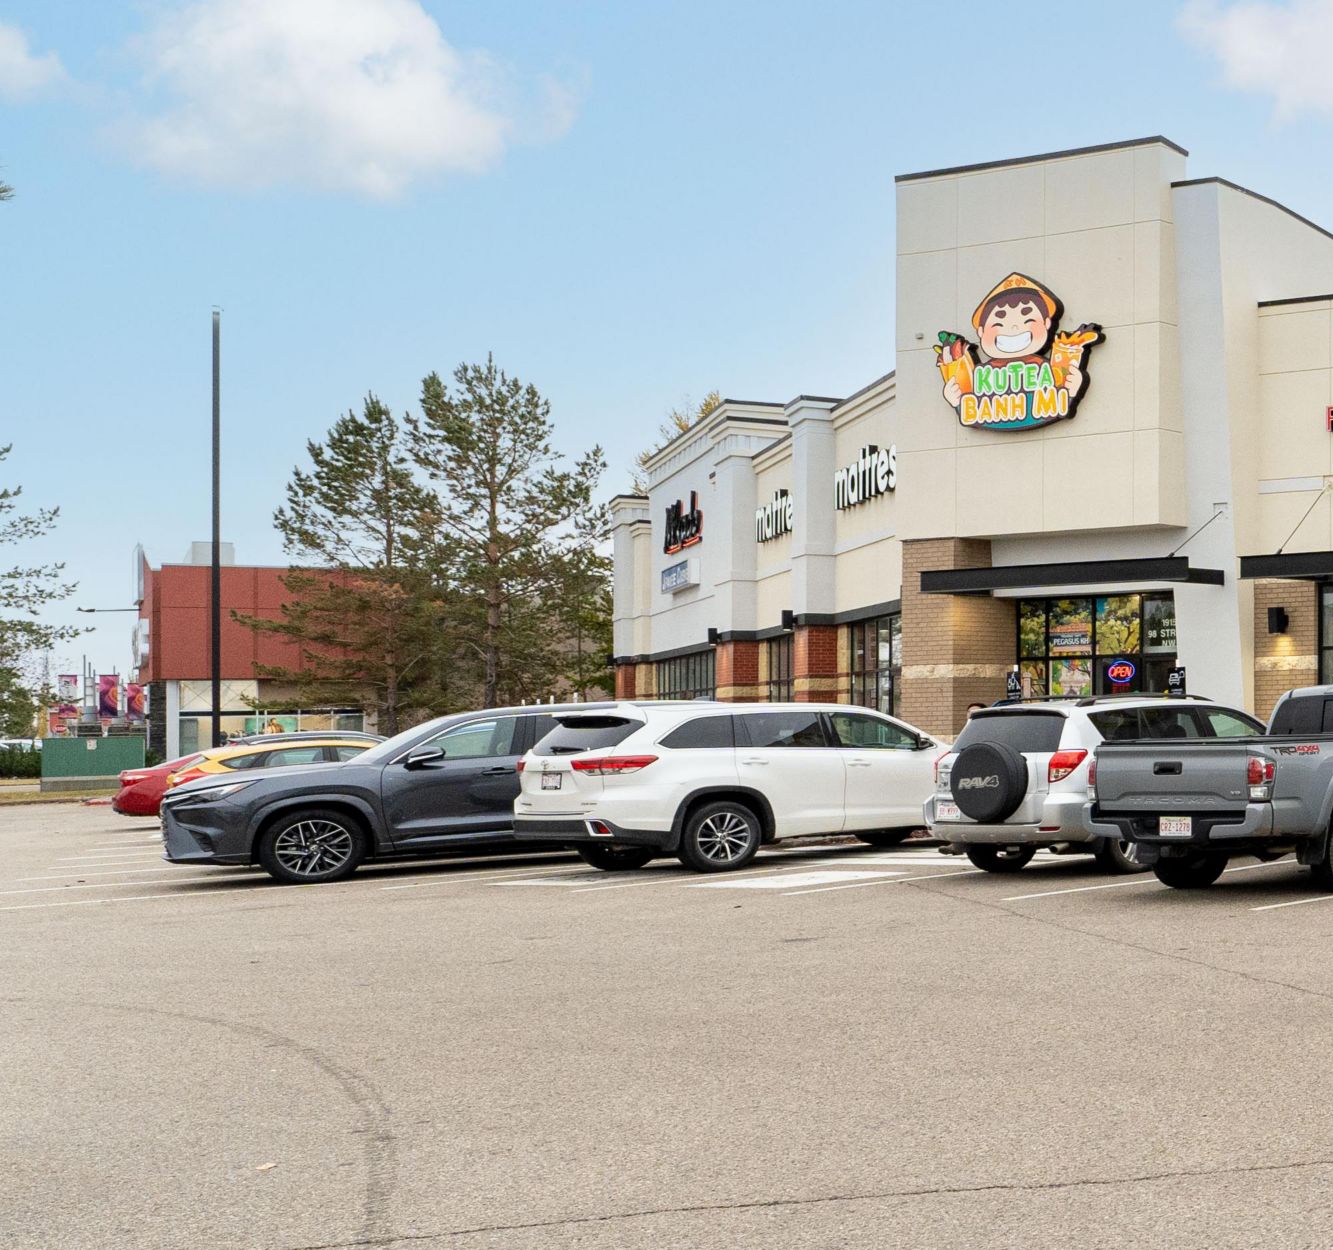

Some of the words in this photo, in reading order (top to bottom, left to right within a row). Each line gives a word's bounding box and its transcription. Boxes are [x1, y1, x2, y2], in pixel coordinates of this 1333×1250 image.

[975, 362, 1054, 395] KUTEA
[961, 394, 1026, 424] BANH
[1033, 387, 1068, 417] MI
[1148, 630, 1157, 638] 98
[1053, 637, 1080, 646] PEGASUS
[1110, 664, 1132, 677] OPEN
[958, 775, 1000, 790] RAV4
[1129, 797, 1217, 806] TACOMA
